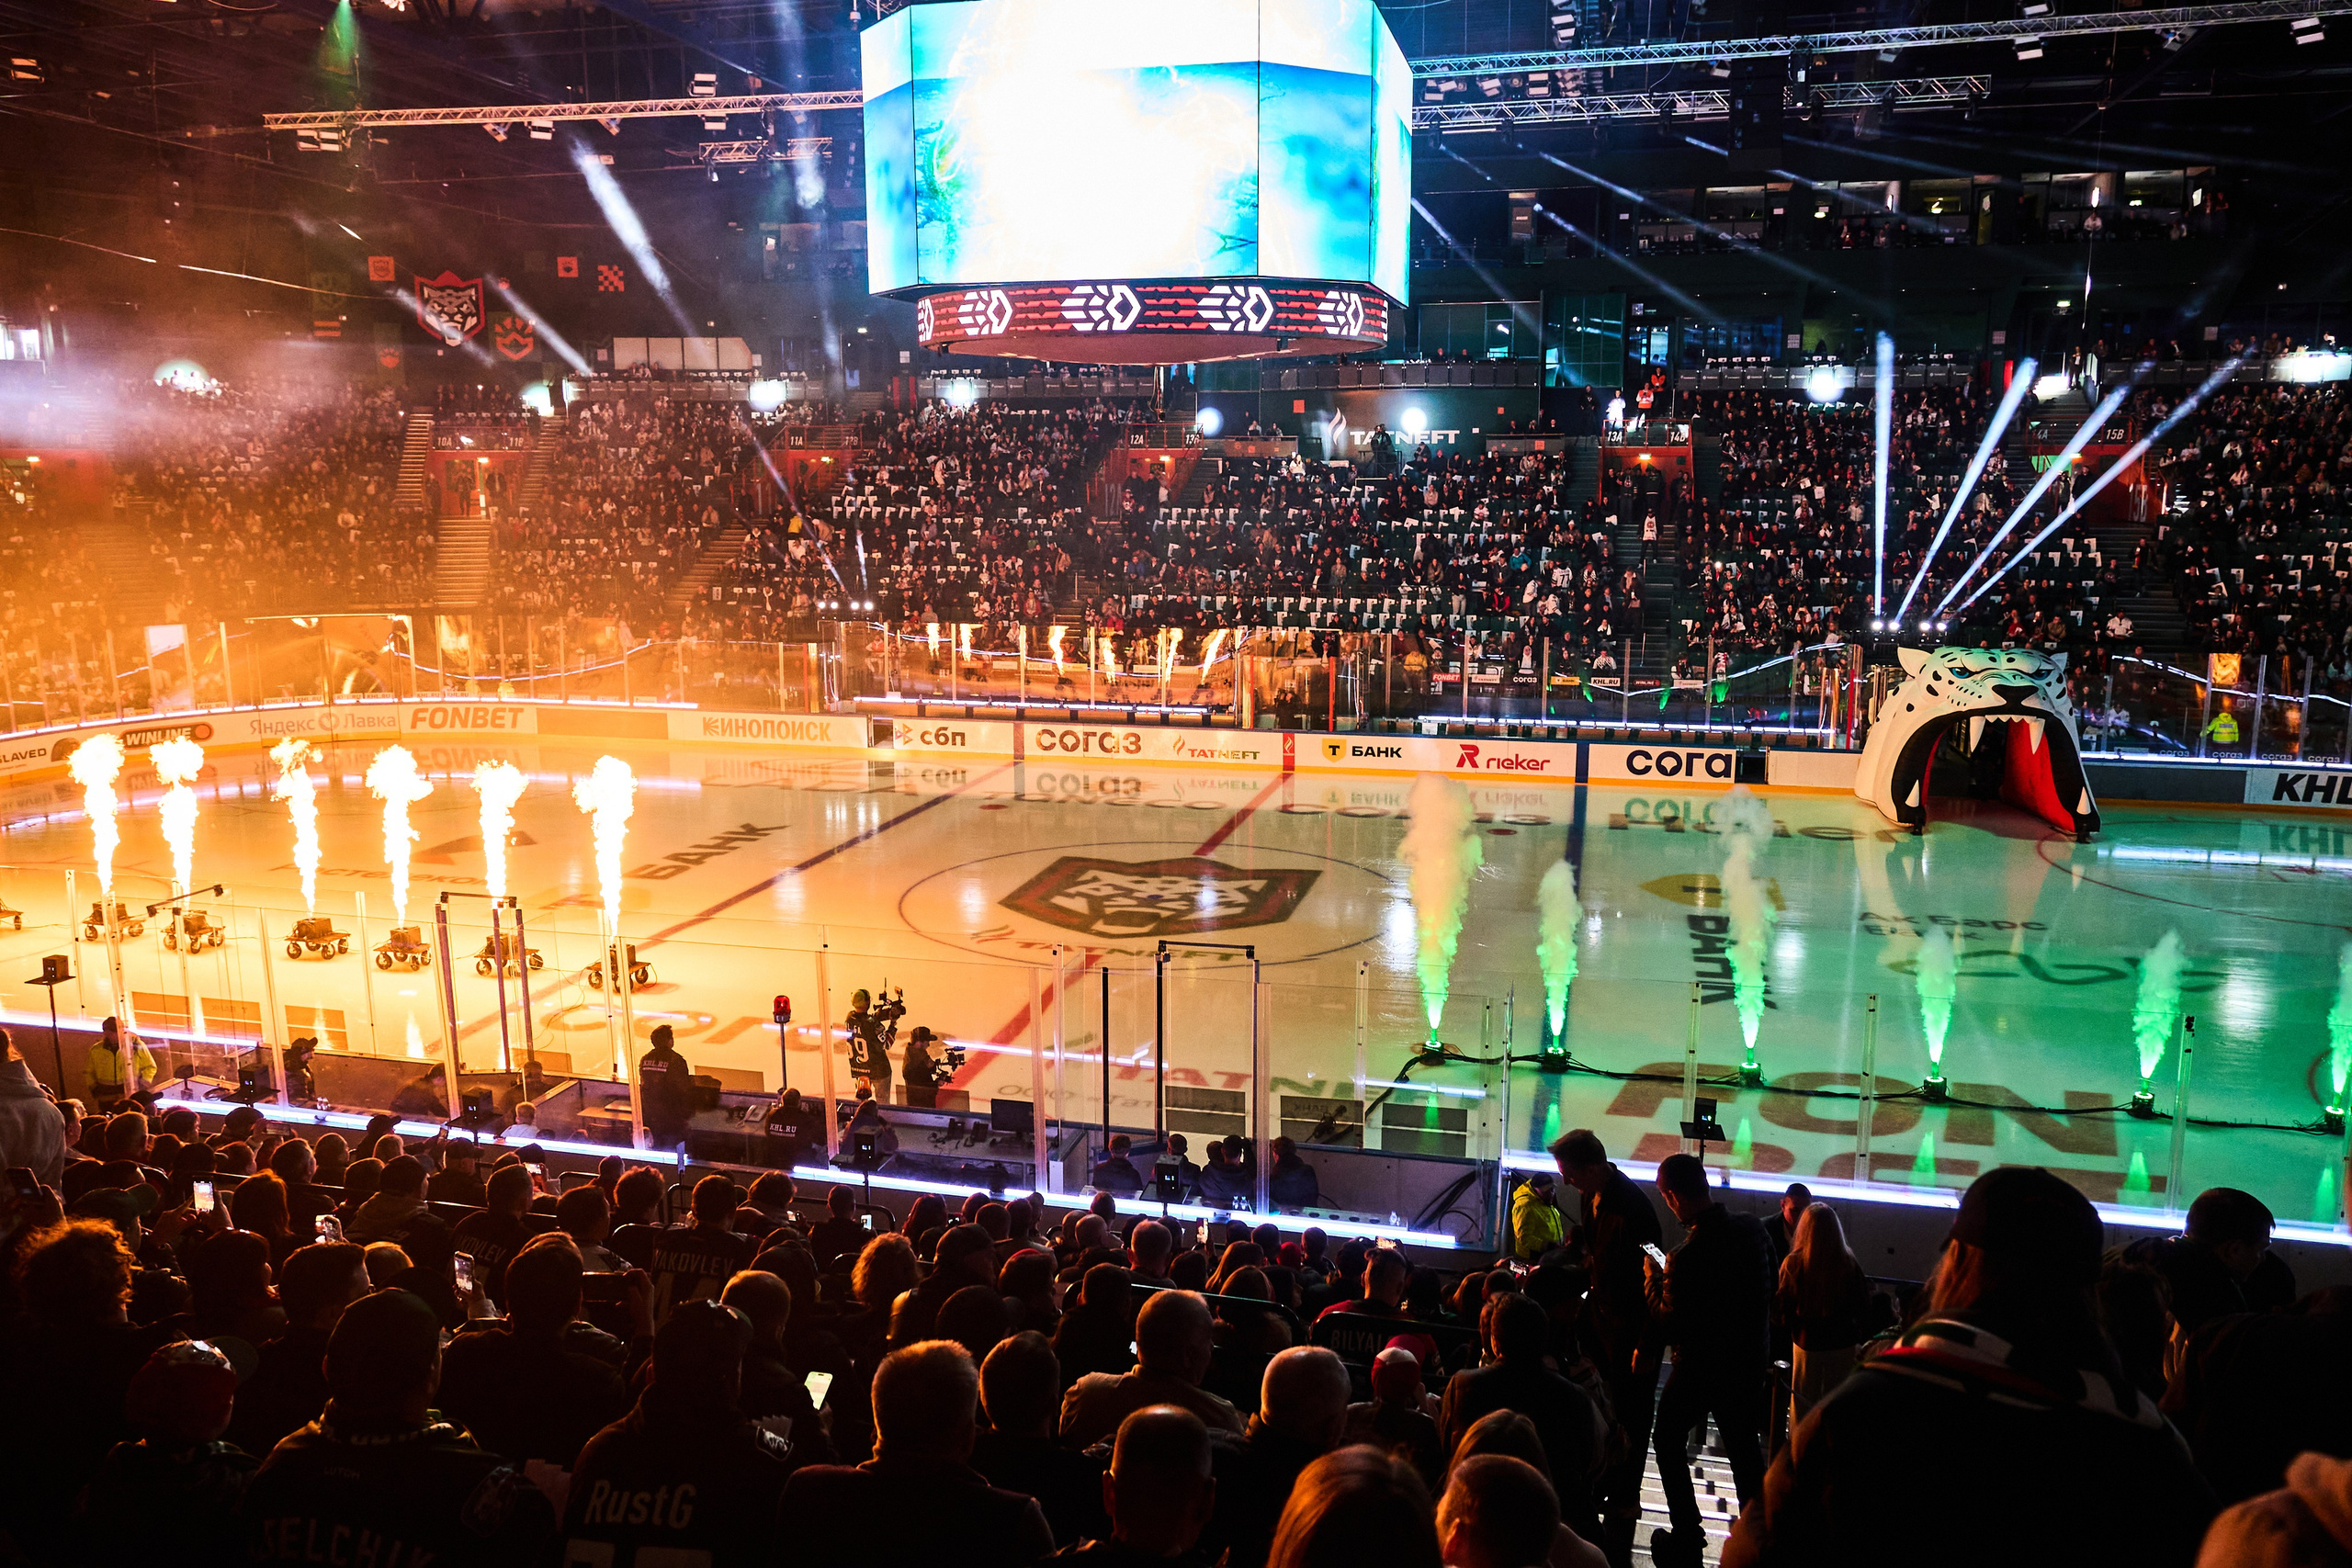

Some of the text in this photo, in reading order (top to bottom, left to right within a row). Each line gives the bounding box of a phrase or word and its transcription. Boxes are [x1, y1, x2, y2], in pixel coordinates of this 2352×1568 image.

[790, 436, 803, 446] 11A
[1130, 434, 1144, 445] 12A
[1350, 430, 1460, 445] TANEFT
[1608, 432, 1623, 442] 13A
[2106, 429, 2124, 440] 15B
[250, 714, 397, 735] Яндекс Лавка
[411, 706, 524, 729] FONBET
[126, 728, 191, 746] WINLINE
[702, 716, 831, 741] КИНОПОИСК
[920, 727, 966, 746] сбп
[1035, 728, 1142, 755] согаз
[0, 748, 47, 764] LAVED
[1188, 748, 1260, 761] TATNEFT
[1351, 746, 1402, 758] БАНК
[1486, 753, 1551, 771] rieker
[1627, 750, 1733, 779] сога
[1276, 803, 1553, 827] соз
[620, 823, 792, 881] БАНК
[267, 862, 510, 886] Рстееко
[1928, 915, 2049, 931] Барс
[770, 1122, 797, 1133] KHL.RU
[582, 1478, 698, 1531] RustG
